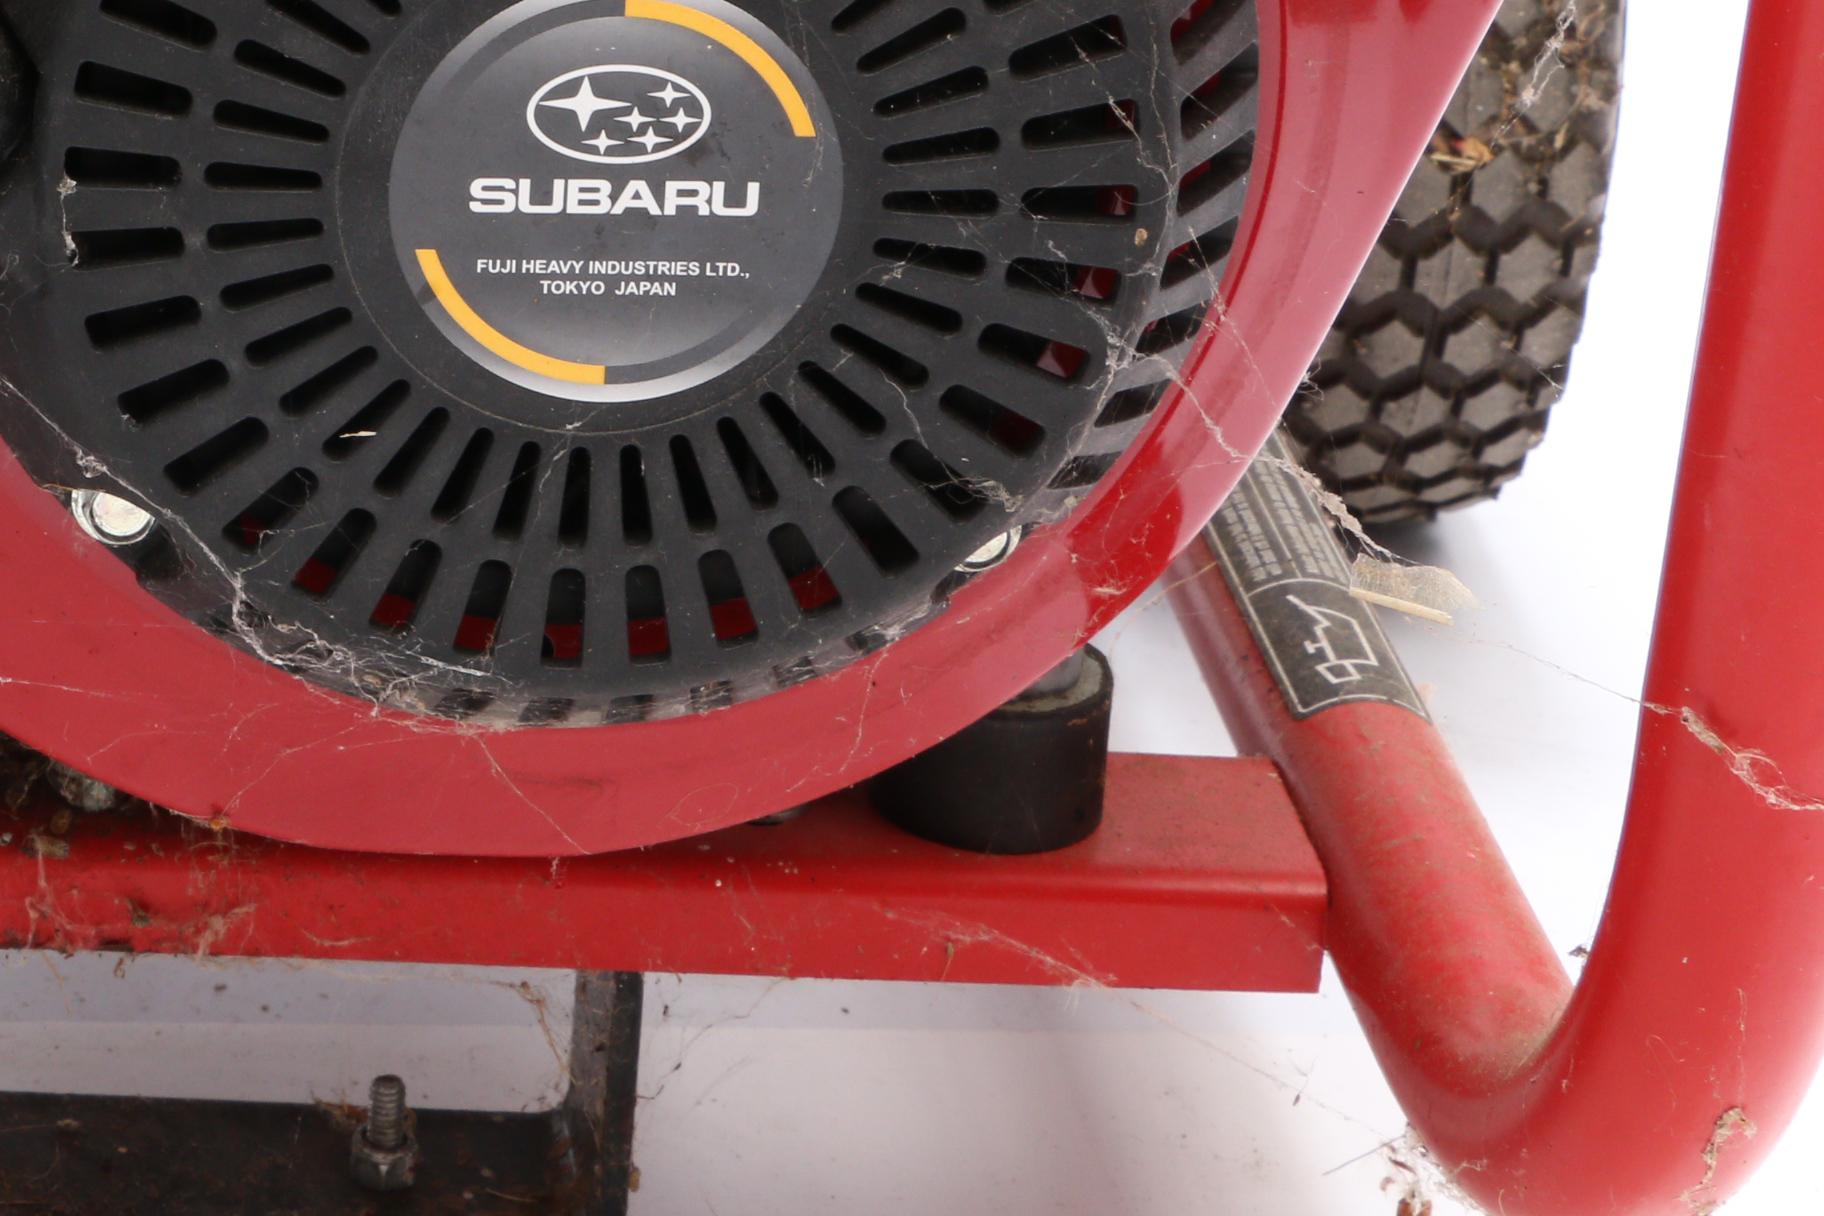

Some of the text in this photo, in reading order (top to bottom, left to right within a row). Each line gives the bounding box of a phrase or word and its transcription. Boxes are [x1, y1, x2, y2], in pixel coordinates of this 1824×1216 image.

[468, 178, 760, 217] SUBARU
[476, 260, 750, 279] FUJI HEAVY INDUSTRIES LTD.,
[539, 281, 676, 296] TOKYO JAPAN
